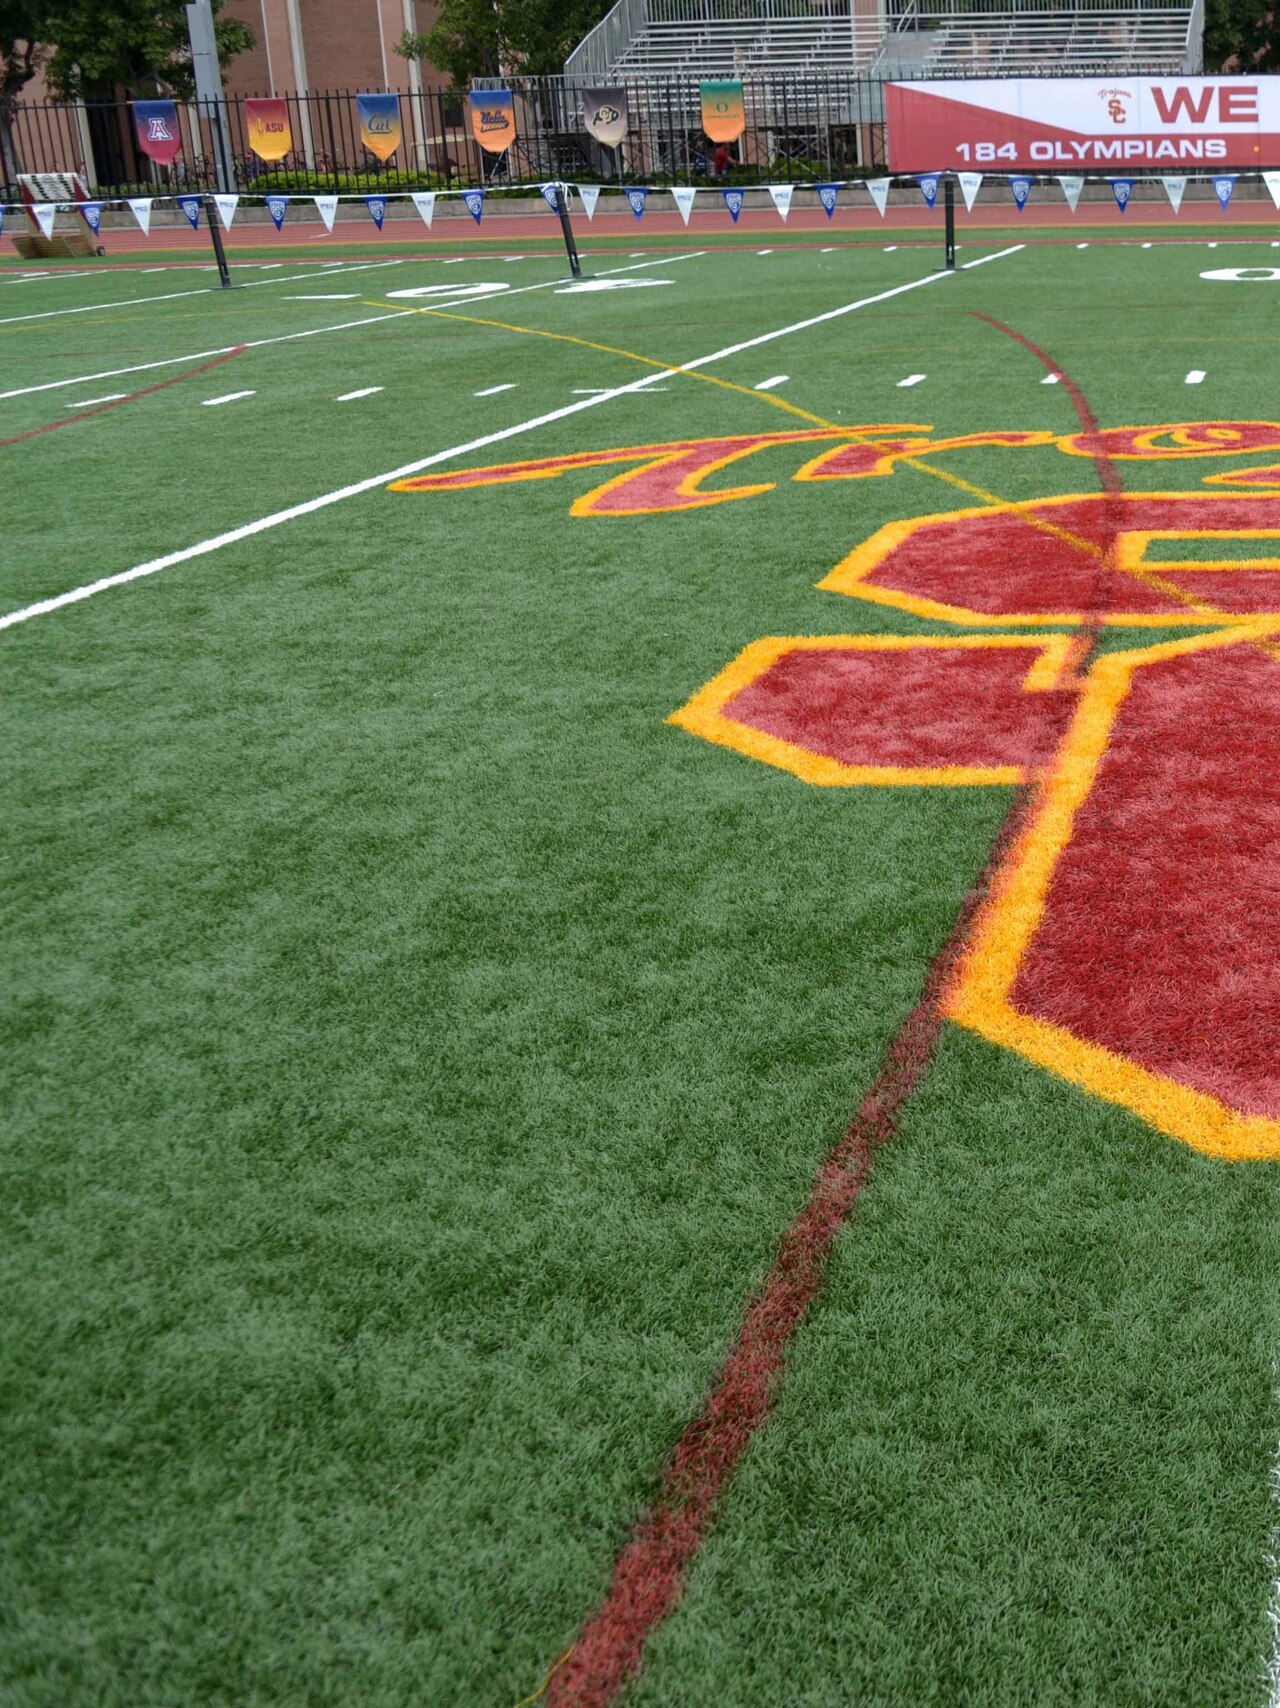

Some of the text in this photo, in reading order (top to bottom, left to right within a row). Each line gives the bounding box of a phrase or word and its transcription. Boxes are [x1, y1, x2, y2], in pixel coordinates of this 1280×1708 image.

[1151, 86, 1258, 123] WE
[265, 122, 284, 132] ASU
[367, 113, 392, 132] Cal
[955, 139, 1227, 162] 184 OLYMPIANS
